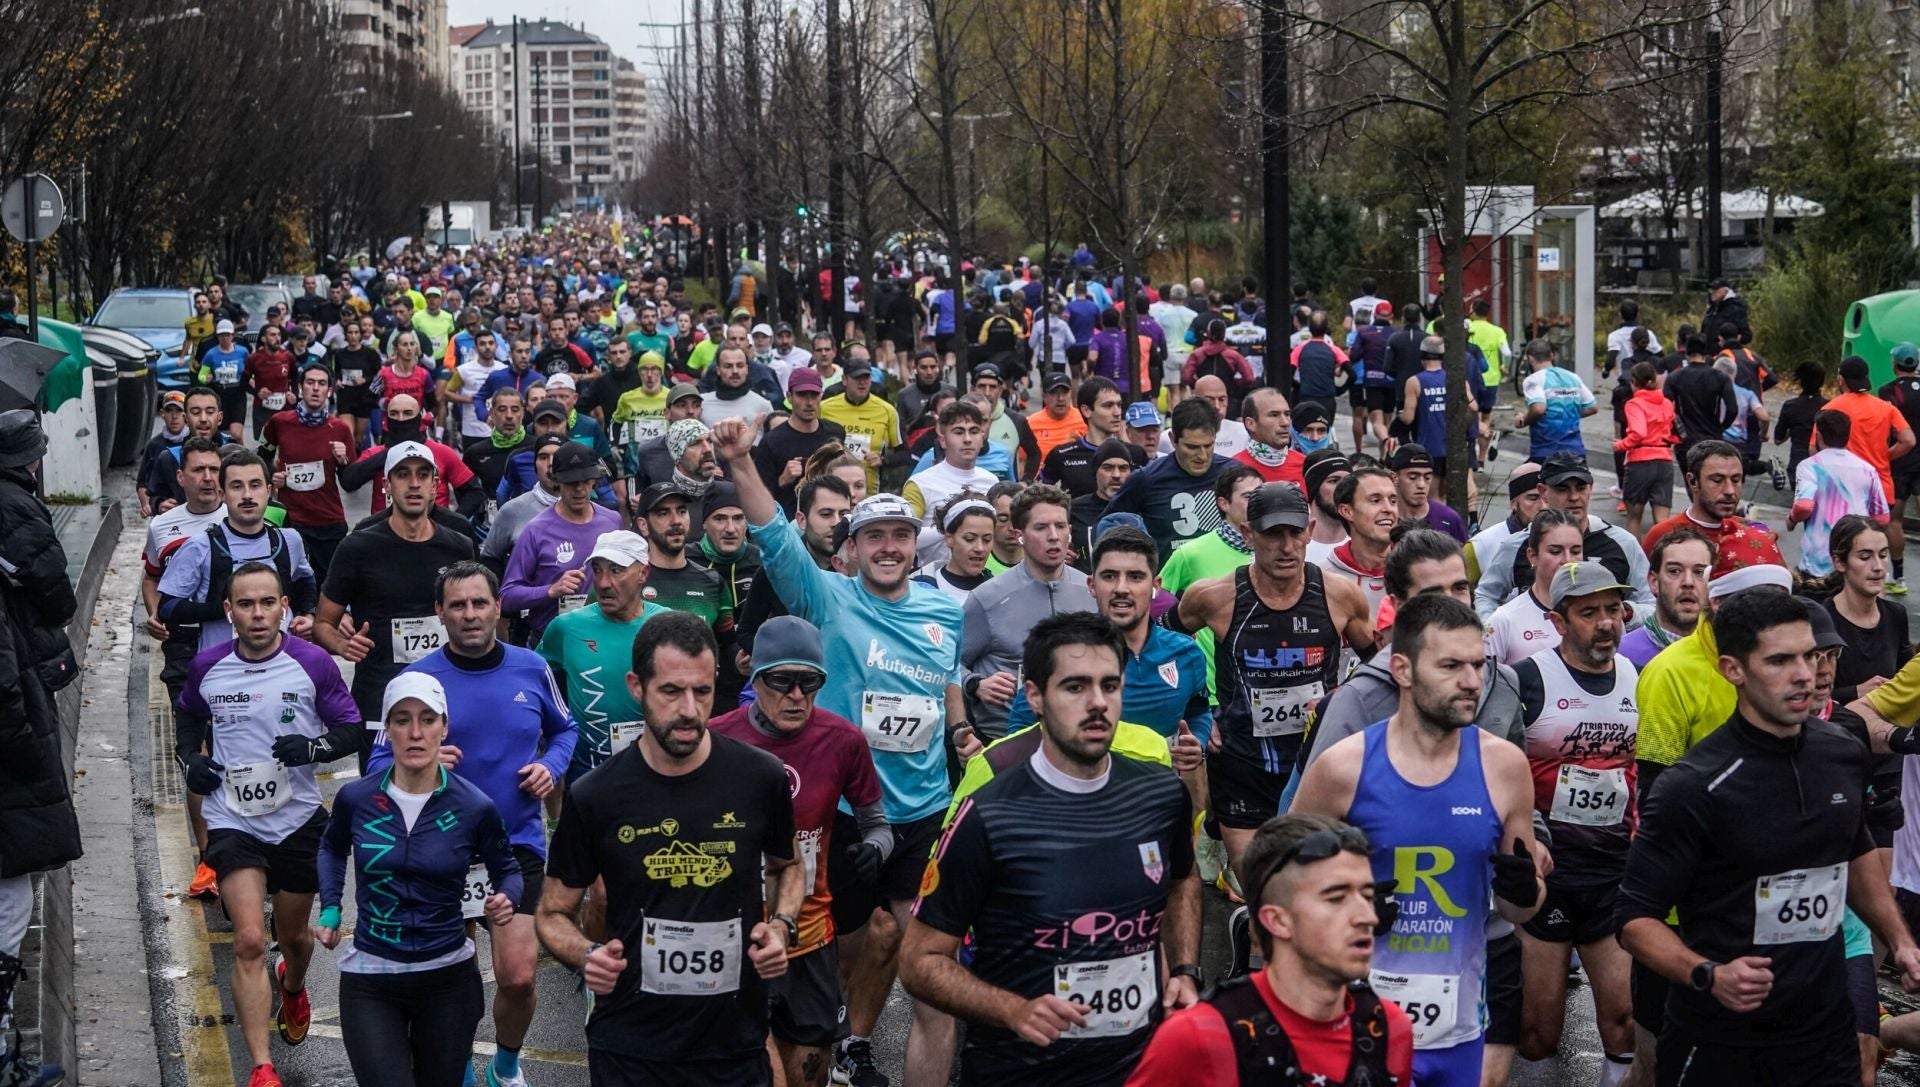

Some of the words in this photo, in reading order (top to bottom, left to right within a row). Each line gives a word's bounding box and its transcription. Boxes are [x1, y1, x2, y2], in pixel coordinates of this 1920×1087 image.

[641, 428, 659, 436] 765
[294, 473, 315, 484] 527
[1171, 492, 1199, 536] 3
[403, 633, 440, 651] 1732
[867, 639, 948, 686] Kutxabank
[210, 692, 250, 705] lamedia
[879, 716, 921, 736] 477
[235, 780, 277, 802] 1669
[1568, 787, 1617, 810] 1354
[650, 857, 676, 865] HIRU
[679, 857, 712, 865] MENDI
[654, 865, 698, 877] TRAIL
[1396, 900, 1427, 916] CLUB
[1778, 894, 1828, 924] 650
[1391, 916, 1453, 934] MARATÓN
[1388, 934, 1450, 953] RIOJA
[658, 949, 725, 974] 1058
[1393, 1001, 1441, 1027] 59
